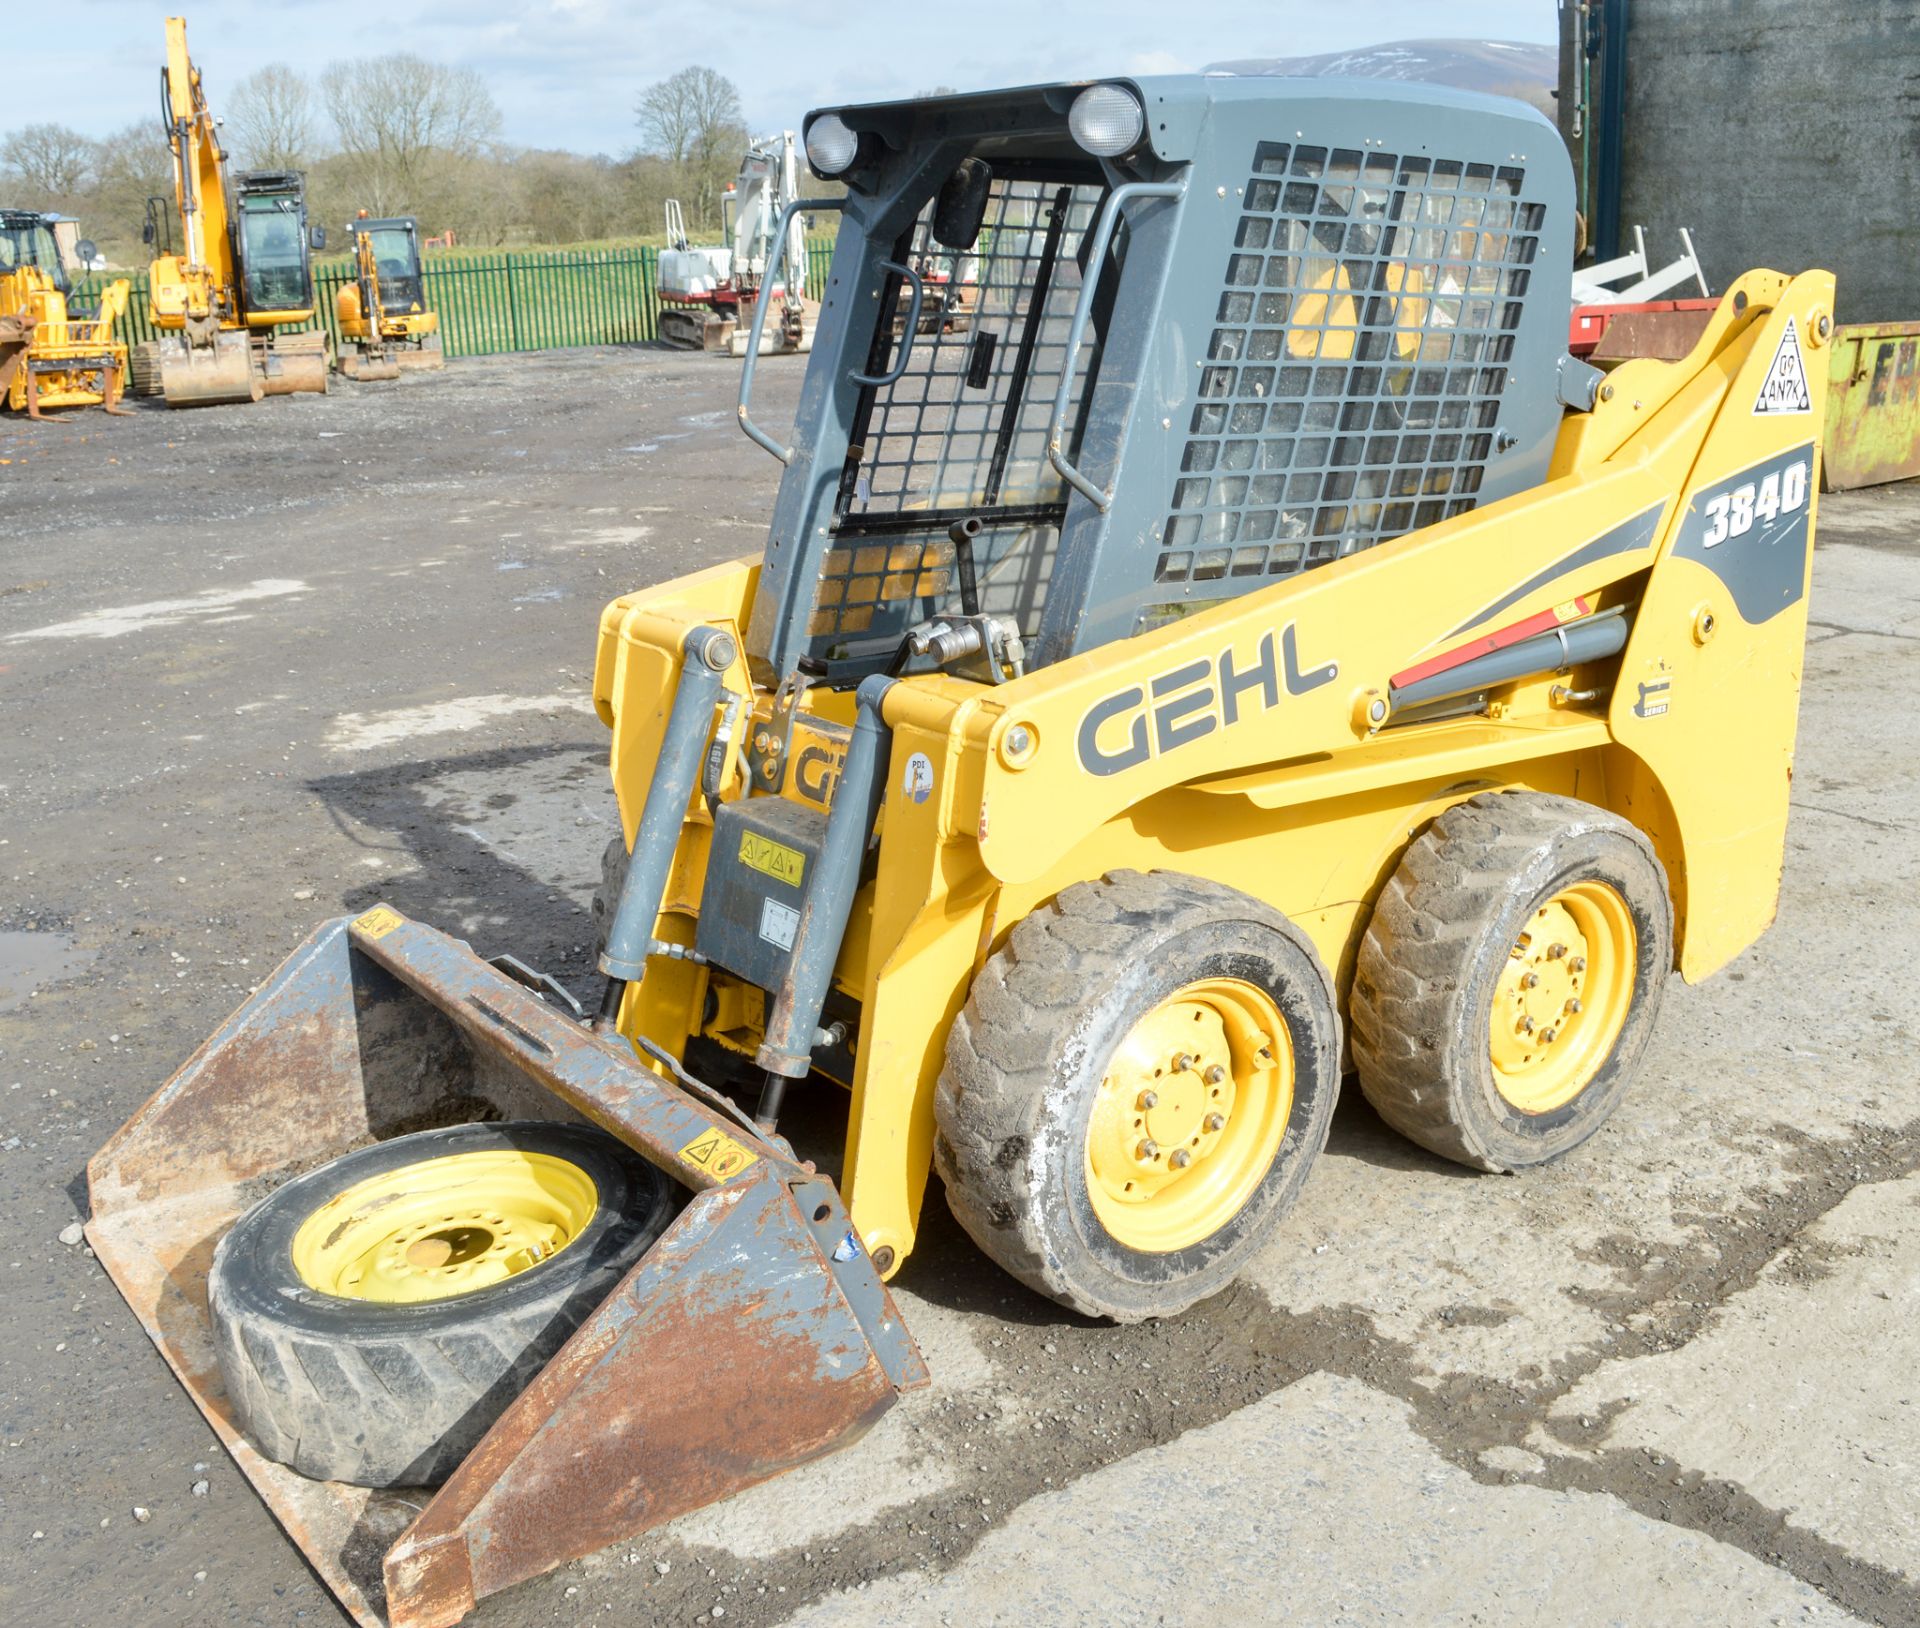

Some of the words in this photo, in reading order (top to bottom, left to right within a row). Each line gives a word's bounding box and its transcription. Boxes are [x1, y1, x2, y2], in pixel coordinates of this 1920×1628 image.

[1703, 460, 1807, 549] 3840
[1077, 623, 1338, 777] GEHL
[912, 760, 925, 769] PDI
